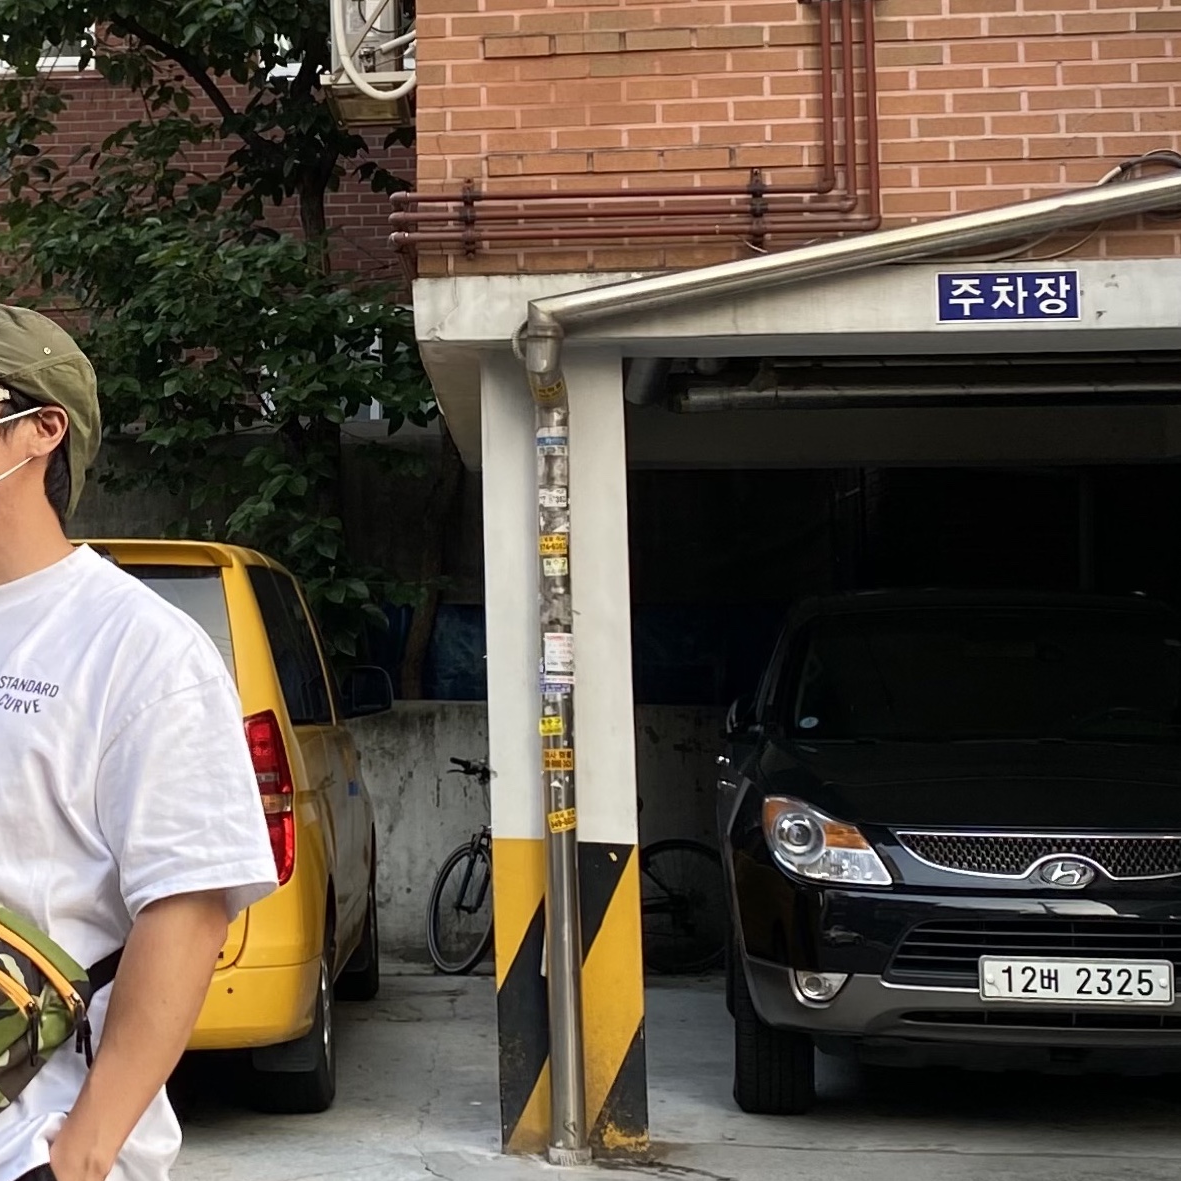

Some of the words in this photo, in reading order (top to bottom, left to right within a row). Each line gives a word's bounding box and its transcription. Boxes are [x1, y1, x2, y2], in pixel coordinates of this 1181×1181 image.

[948, 275, 1071, 317] 주차장
[1002, 965, 1059, 993] 12버
[1076, 967, 1154, 996] 2325
